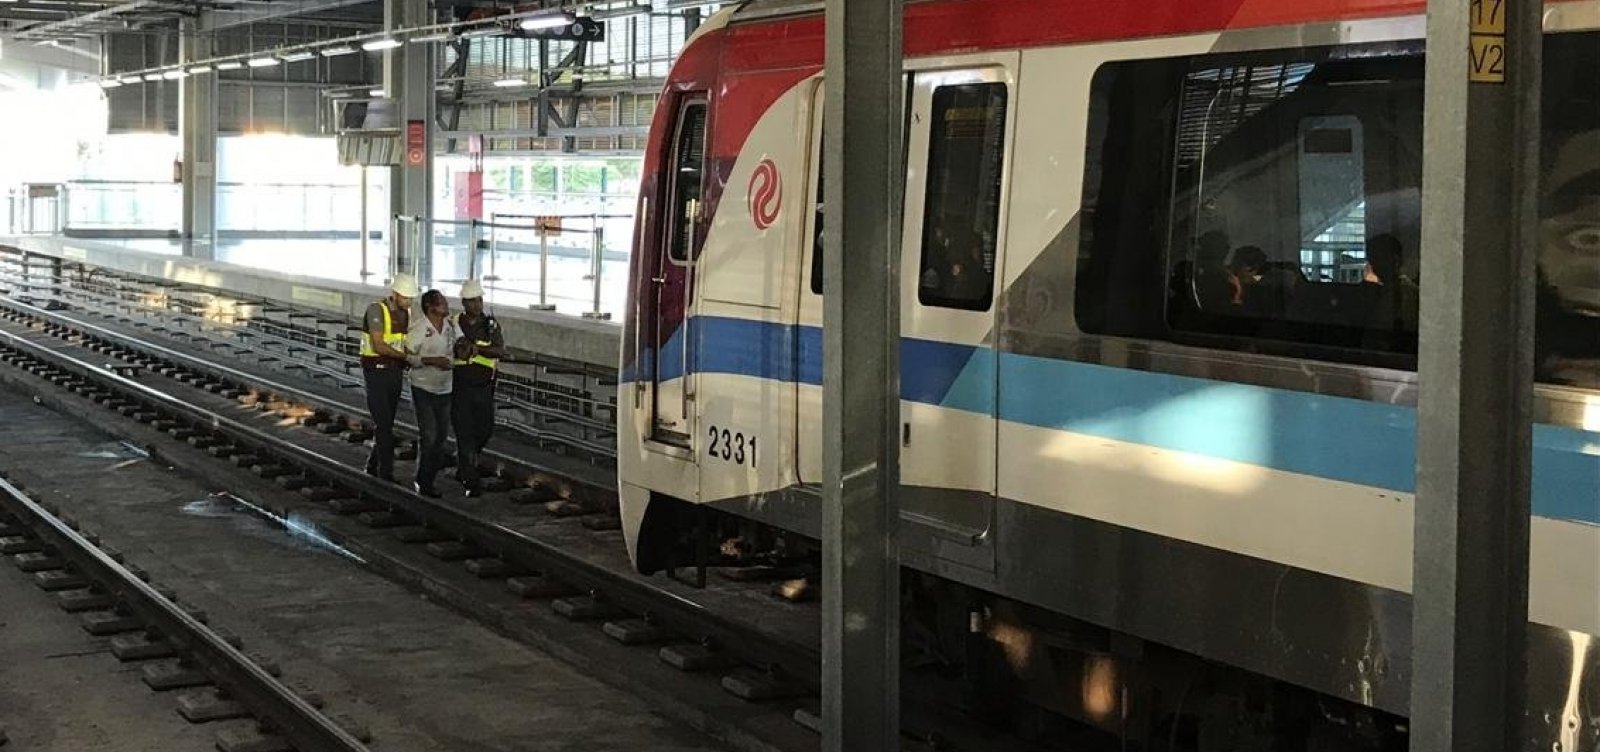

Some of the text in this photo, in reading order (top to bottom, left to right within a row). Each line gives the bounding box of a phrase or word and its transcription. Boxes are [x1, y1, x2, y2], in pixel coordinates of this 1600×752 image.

[1472, 0, 1502, 25] 17
[1470, 44, 1503, 74] V2
[708, 425, 756, 468] 2331
